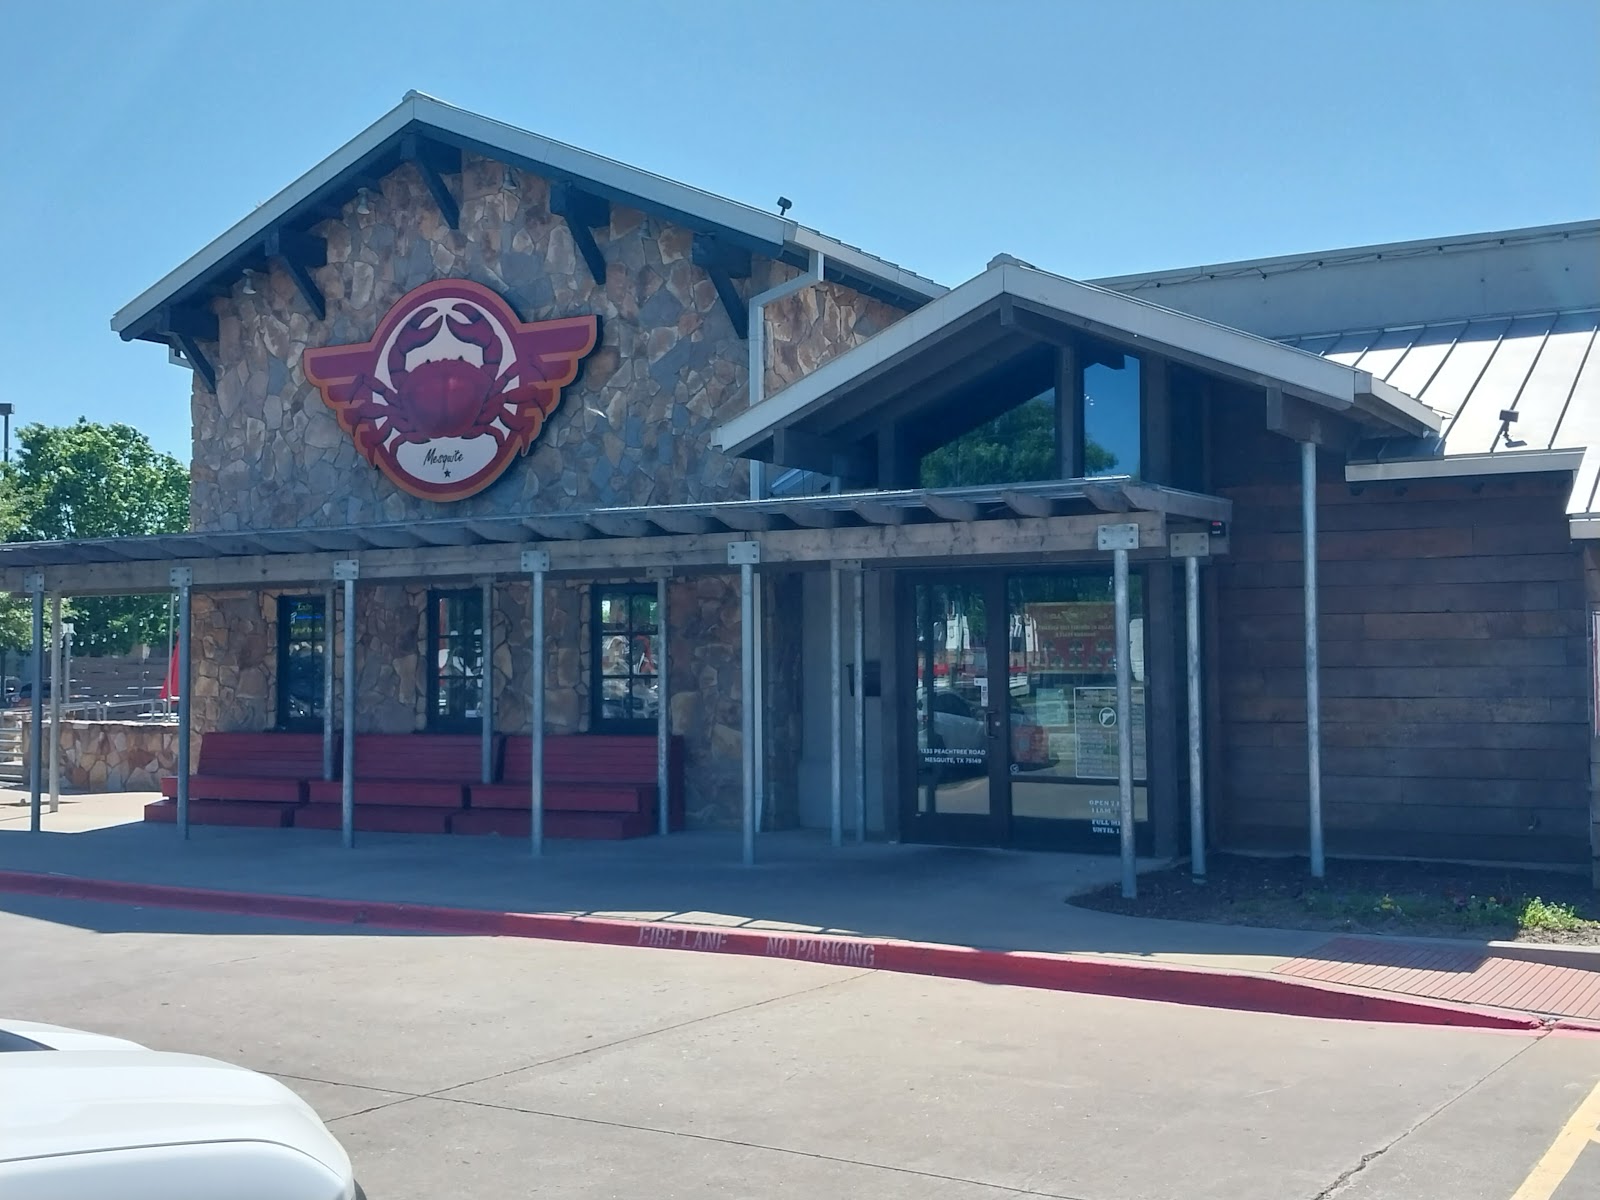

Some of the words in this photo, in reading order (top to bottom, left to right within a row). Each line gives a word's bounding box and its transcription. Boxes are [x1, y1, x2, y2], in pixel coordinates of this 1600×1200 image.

[423, 447, 464, 470] Mesquite
[1092, 826, 1115, 834] UNTIL
[766, 936, 790, 955] NO
[795, 938, 875, 966] PARKING
